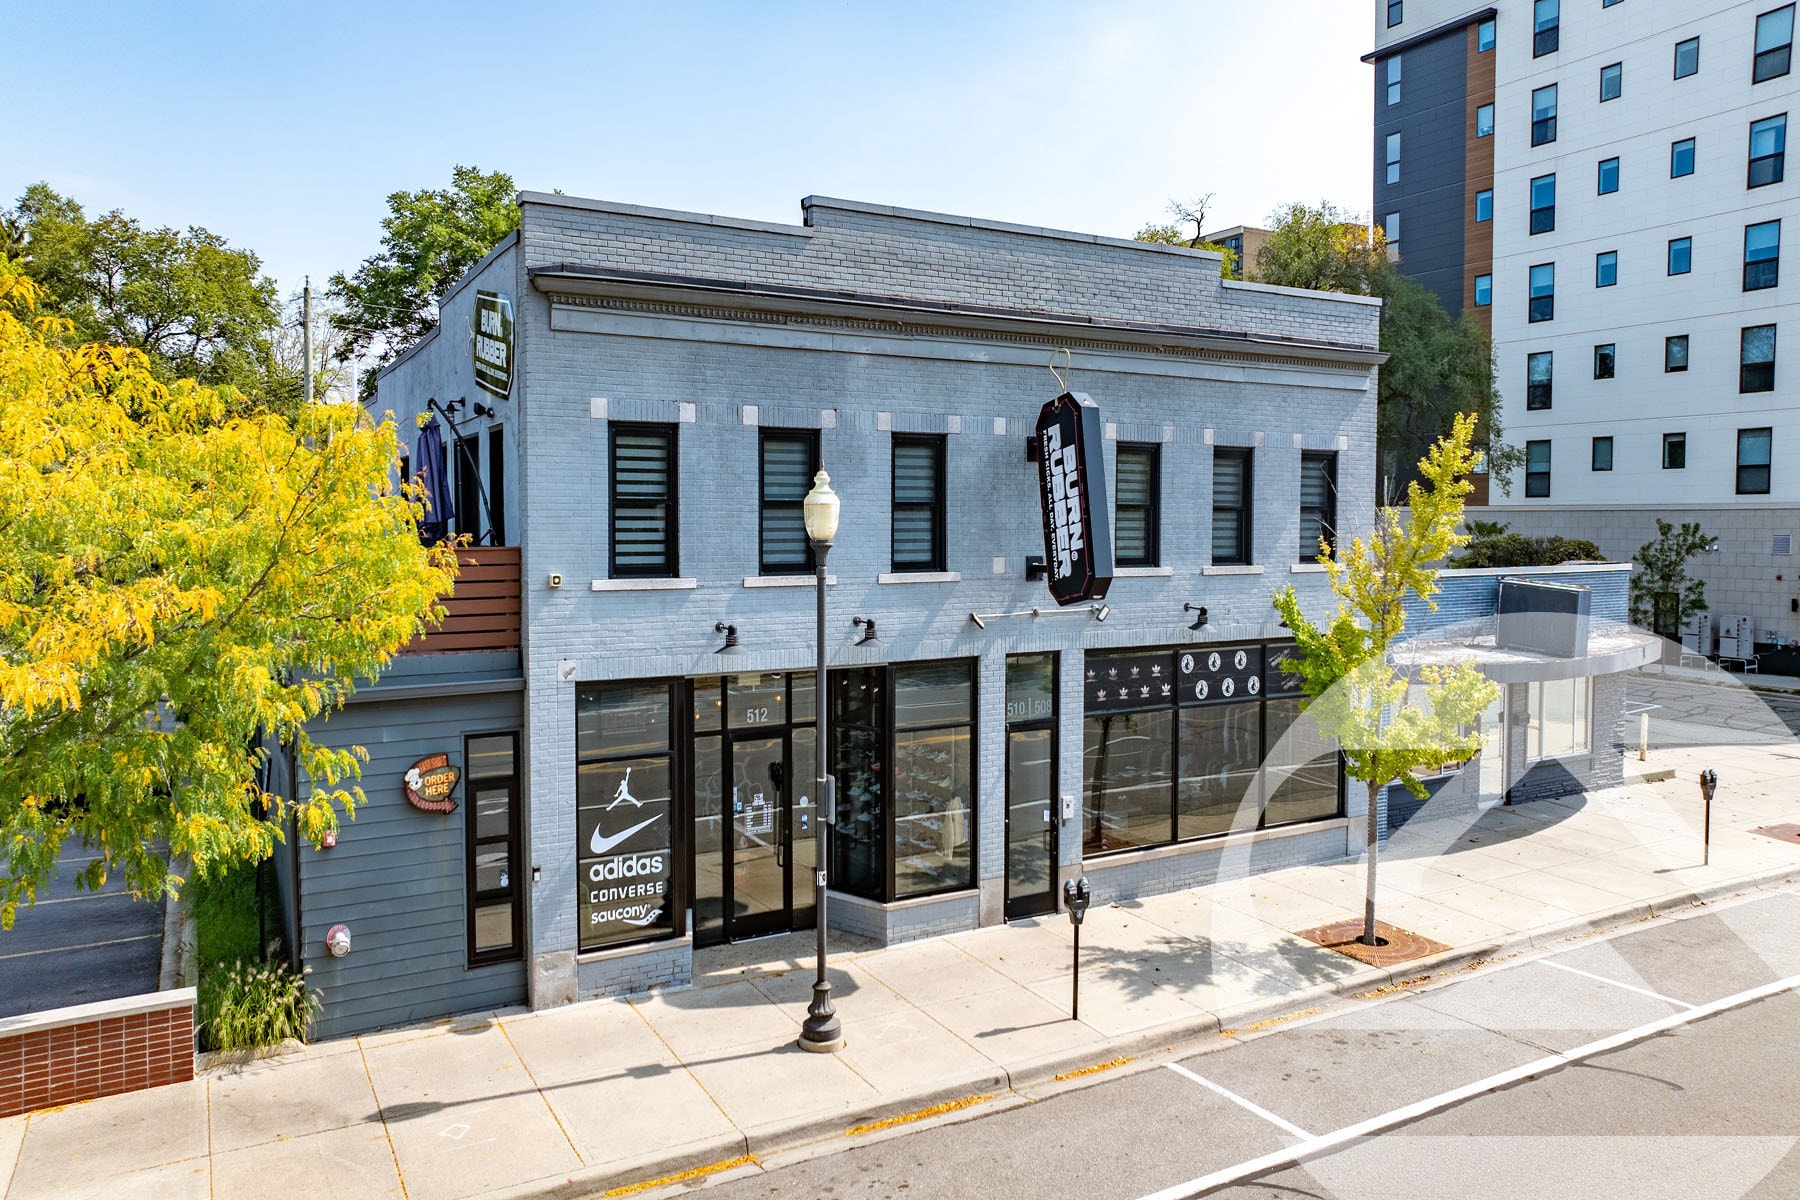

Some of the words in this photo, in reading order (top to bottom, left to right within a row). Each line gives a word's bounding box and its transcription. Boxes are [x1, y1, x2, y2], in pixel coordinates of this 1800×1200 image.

[476, 334, 507, 368] RUBBER
[1047, 423, 1072, 579] RUBBER
[1063, 444, 1084, 552] BURN
[746, 708, 768, 724] 512
[1007, 701, 1025, 716] 510
[1034, 699, 1052, 713] 508
[424, 771, 455, 787] ORDER
[425, 783, 449, 797] HERE
[589, 854, 663, 882] adidas
[590, 881, 663, 904] CONVERSE
[591, 903, 648, 925] saucony
